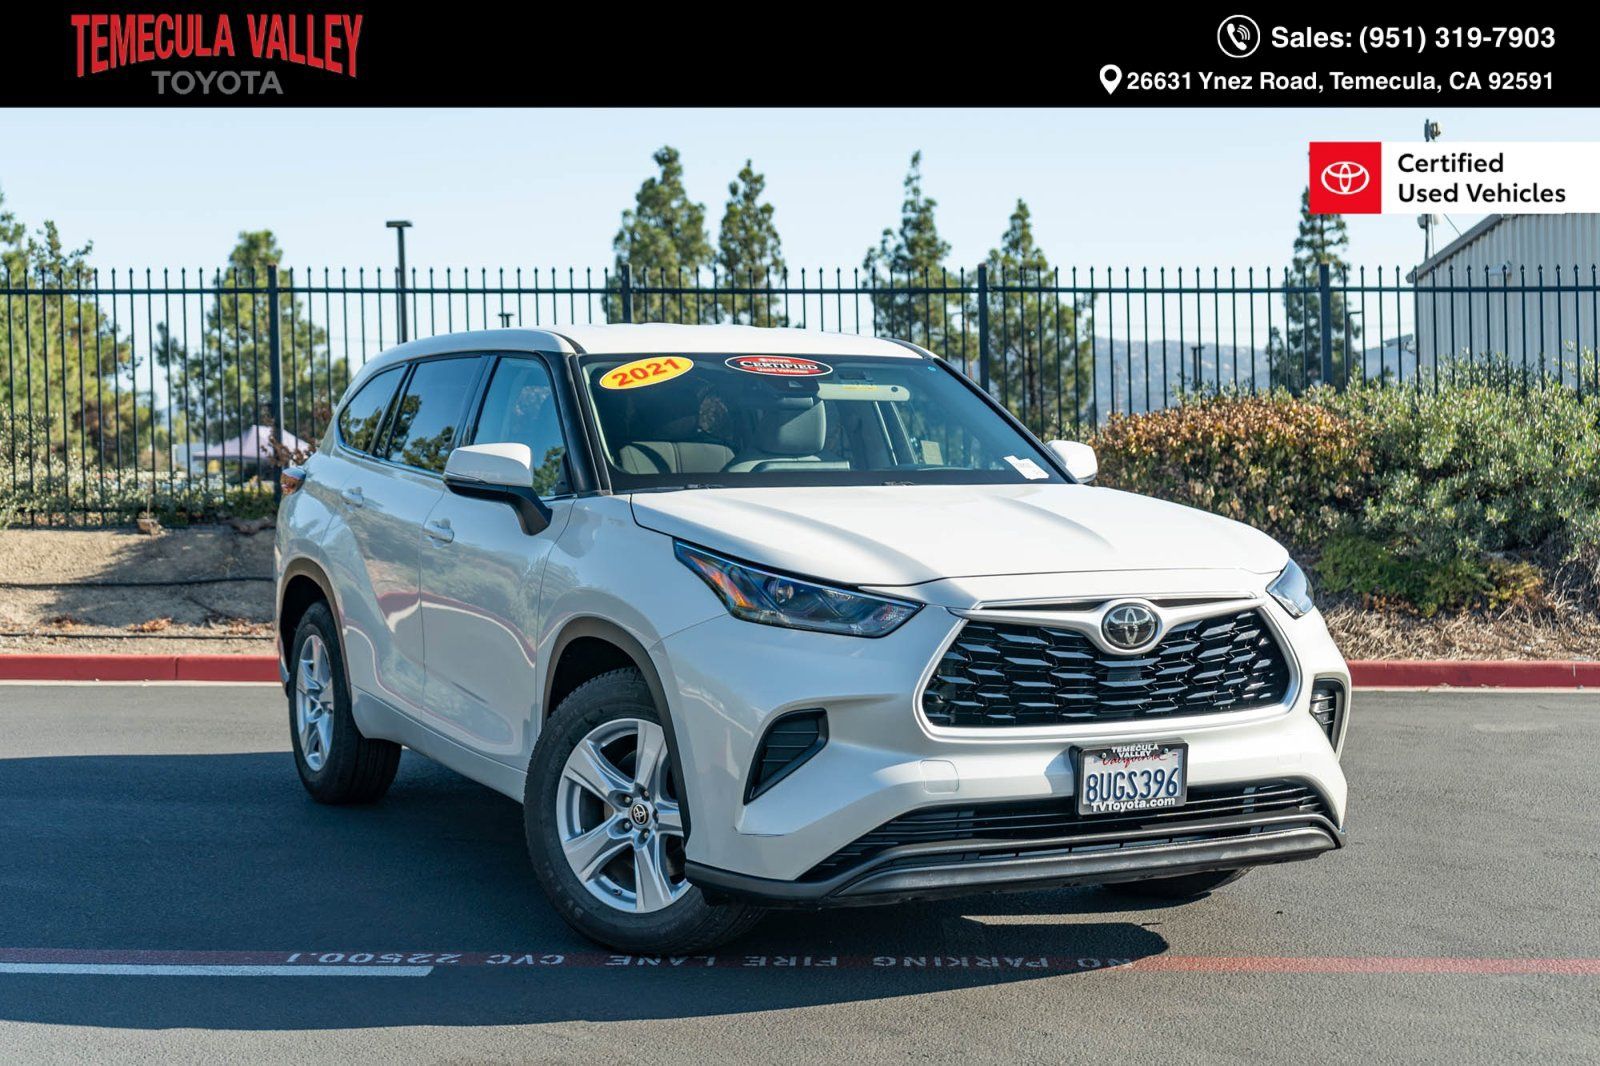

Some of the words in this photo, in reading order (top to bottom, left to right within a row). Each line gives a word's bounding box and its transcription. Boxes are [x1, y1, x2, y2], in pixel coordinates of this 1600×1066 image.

[740, 361, 818, 370] CERTIFIED
[612, 358, 680, 386] 2021
[1111, 743, 1159, 754] TEMECULA
[1118, 750, 1152, 758] VALLEY
[1086, 767, 1179, 802] 8UGS396
[1091, 797, 1176, 813] TVToyota.com
[743, 956, 837, 967] FIRE
[873, 956, 1049, 968] PARKING
